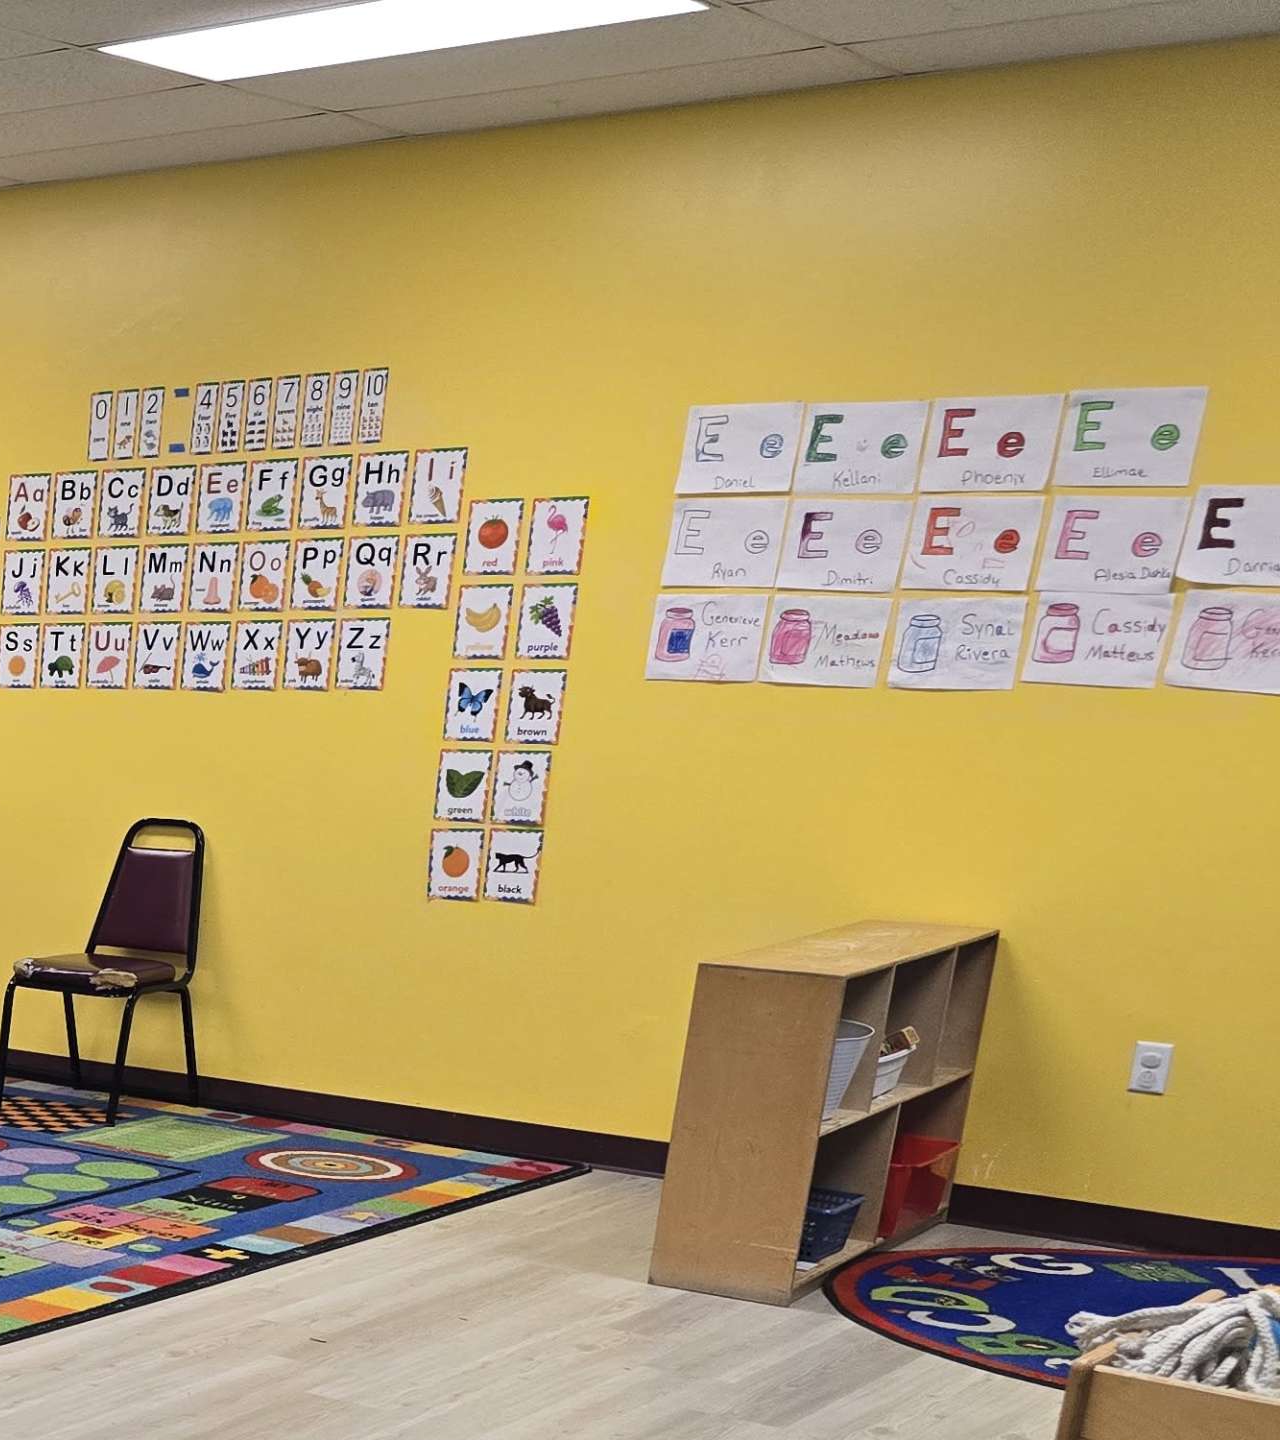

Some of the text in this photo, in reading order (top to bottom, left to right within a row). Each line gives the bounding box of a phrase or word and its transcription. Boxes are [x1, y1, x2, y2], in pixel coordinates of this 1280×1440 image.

[253, 384, 266, 406] 6
[283, 382, 295, 403] 7
[311, 380, 323, 401] 8
[339, 377, 352, 399] 9
[366, 374, 385, 396] 10
[147, 394, 158, 414] 2
[200, 389, 212, 409] 4
[226, 387, 238, 407] 5
[96, 400, 107, 419] 0
[937, 408, 1025, 458] E e
[1072, 401, 1180, 451] E e
[695, 414, 784, 462] E e
[805, 413, 909, 463] E e
[961, 470, 1026, 485] Phoenix
[674, 509, 770, 555] E e
[920, 507, 1020, 556] E e
[1196, 497, 1246, 550] E
[797, 511, 882, 559] E e
[1054, 509, 1163, 560] E e
[482, 558, 498, 567] red
[542, 559, 564, 568] pink
[943, 569, 1001, 586] Cassidy
[527, 642, 558, 653] purple
[954, 644, 1011, 661] Rivera
[460, 724, 479, 734] blue
[517, 727, 547, 736] brown
[448, 806, 472, 815] green
[438, 885, 469, 894] orange
[497, 884, 522, 894] black
[991, 1253, 1094, 1276] G
